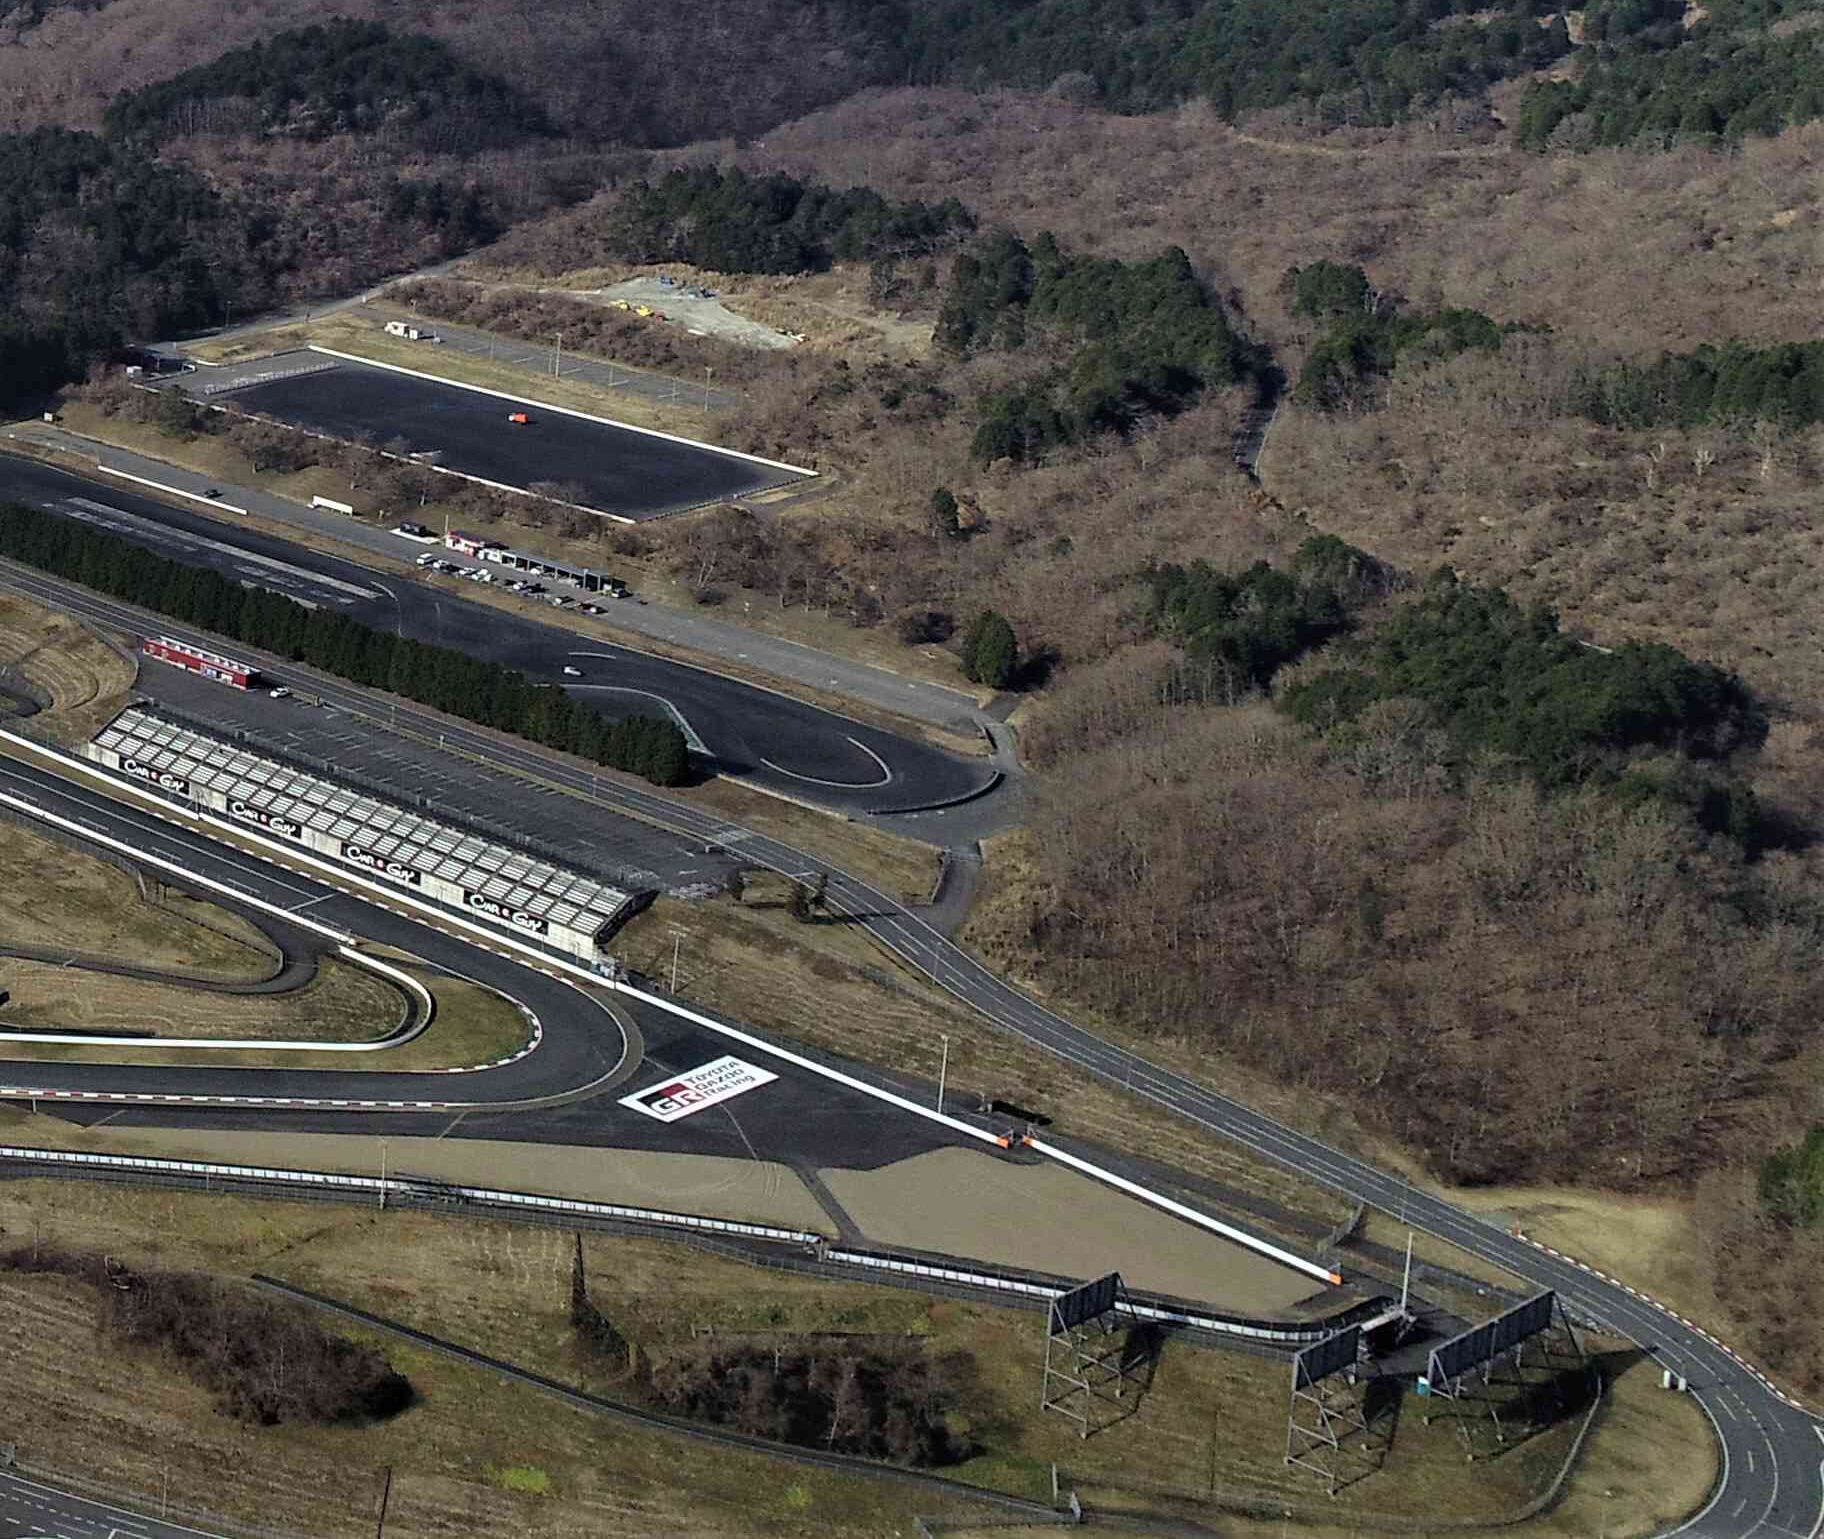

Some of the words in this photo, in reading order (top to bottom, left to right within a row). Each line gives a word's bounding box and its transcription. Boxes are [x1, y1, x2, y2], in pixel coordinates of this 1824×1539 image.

[684, 1061, 740, 1084] TOYOTA
[695, 1068, 745, 1091] GAZOO
[703, 1075, 757, 1098] Racing
[651, 1090, 702, 1113] GR
